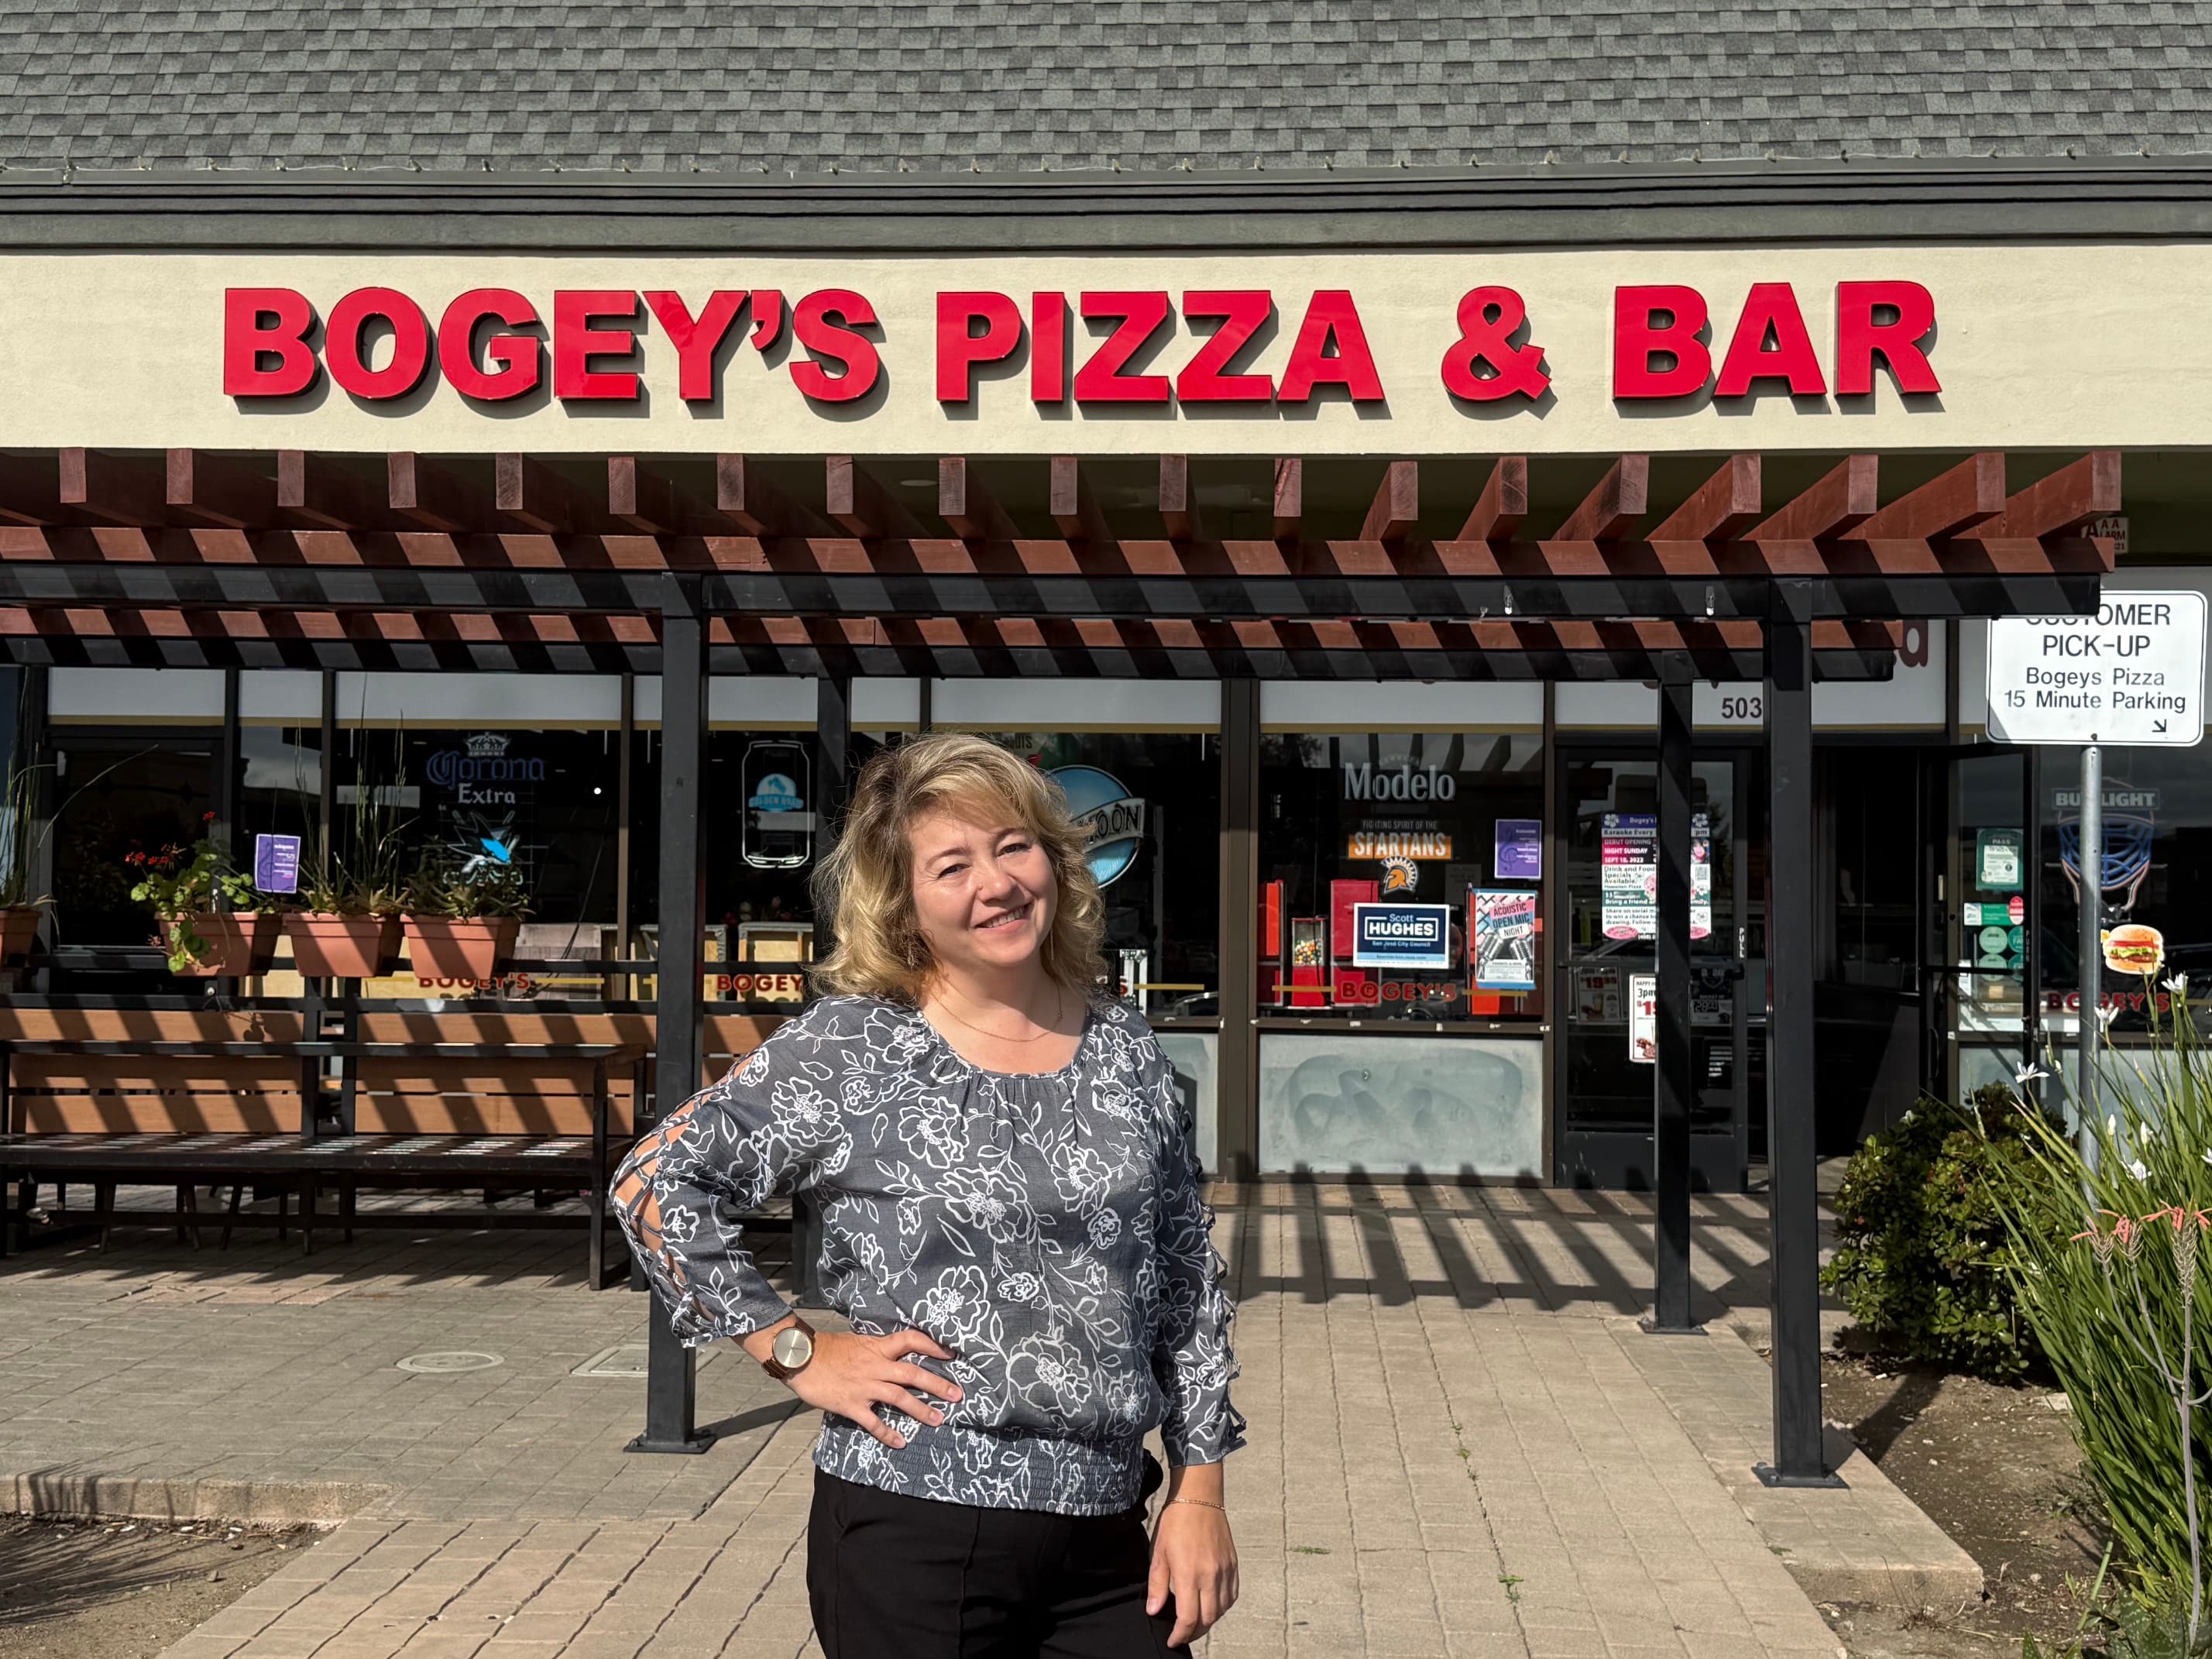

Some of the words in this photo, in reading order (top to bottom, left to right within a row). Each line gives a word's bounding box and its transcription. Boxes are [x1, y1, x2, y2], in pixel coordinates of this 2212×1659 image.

[224, 287, 879, 401] BOGEY'S
[936, 289, 1384, 401] PIZZA
[1441, 285, 1551, 401] &
[1613, 280, 1940, 400] BAR
[2026, 604, 2171, 626] OMER
[2043, 634, 2151, 657] PICK-UP
[2026, 667, 2102, 689] Bogeys
[2113, 668, 2165, 685] Pizza
[1721, 697, 1762, 719] 503
[2004, 690, 2025, 707] 15
[2036, 690, 2102, 709] Minute
[2112, 691, 2186, 713] Parking
[426, 750, 545, 791] Corona
[1344, 762, 1456, 801] Modelo
[458, 782, 516, 804] Extra
[2056, 792, 2081, 806] BU
[2101, 792, 2155, 806] LIGHT
[1354, 832, 1446, 857] SPARTANS
[1389, 913, 1414, 922] Scott
[1493, 902, 1527, 916] ACOUSTIC
[1369, 922, 1434, 936] HUGHES
[1492, 916, 1514, 929] OPEN
[1514, 913, 1530, 926] MIC
[1503, 926, 1523, 936] NIGHT
[717, 974, 803, 991] BOGEY
[1341, 981, 1457, 1001] BOGEY'S
